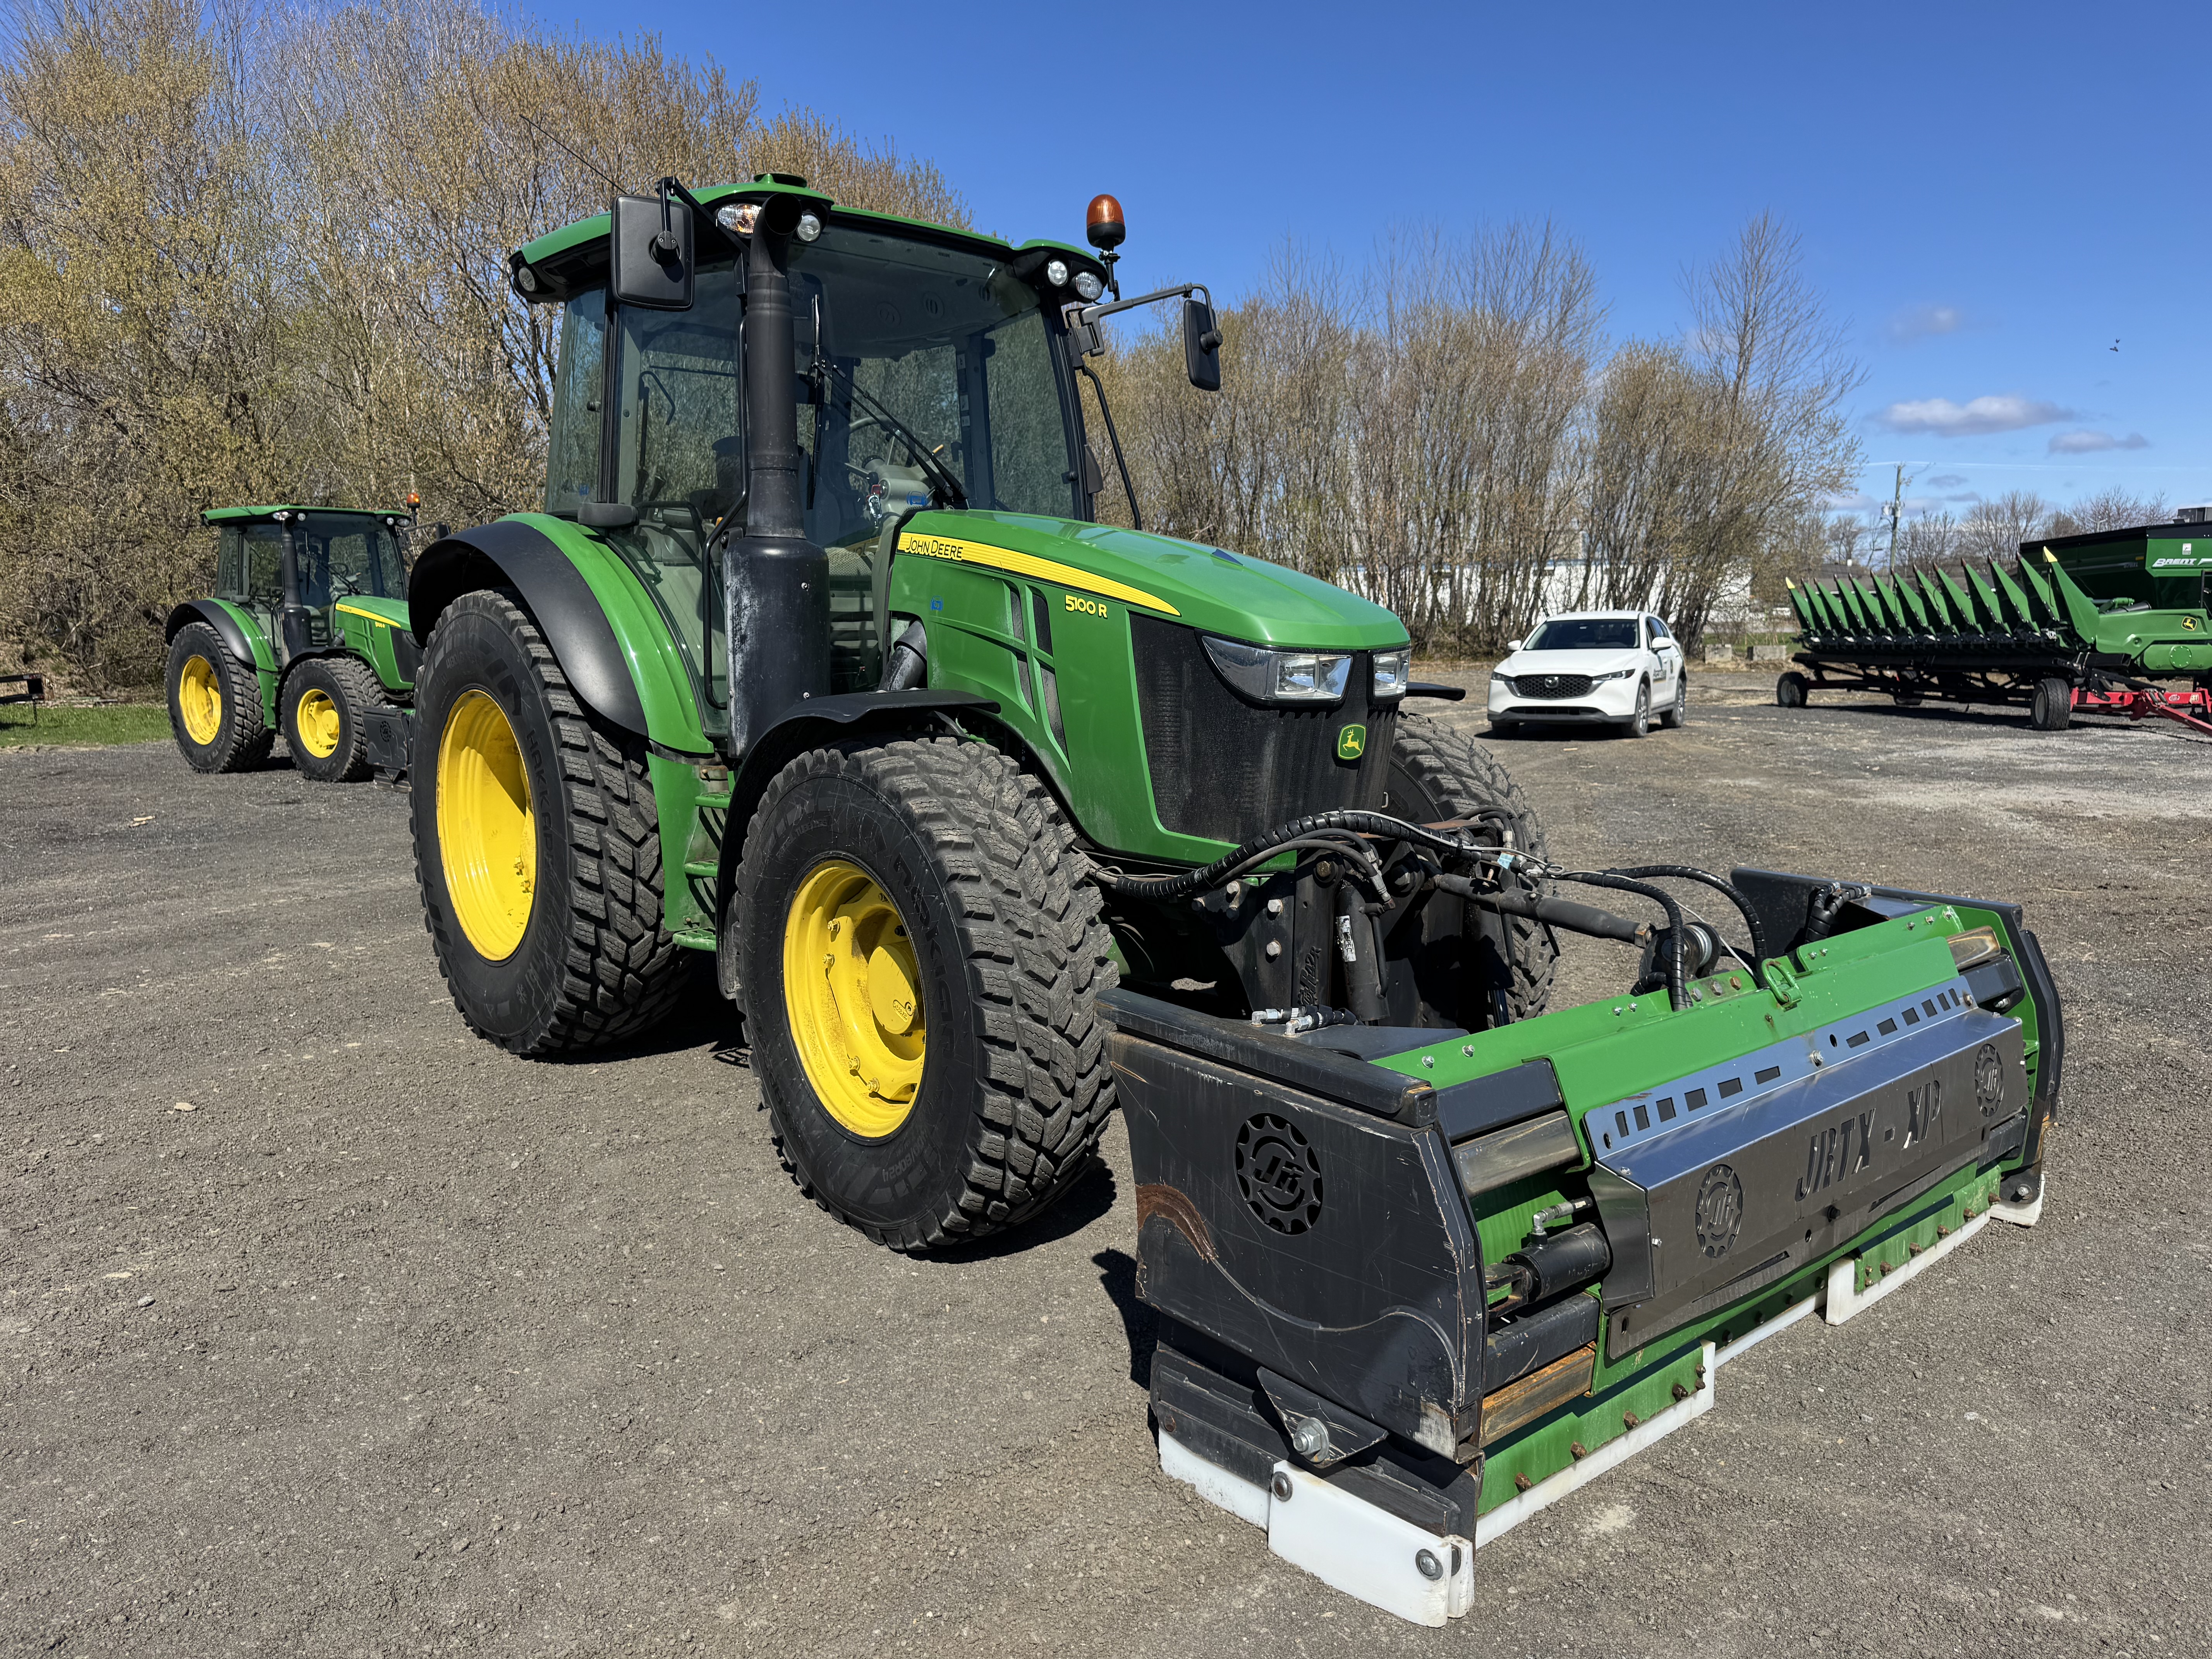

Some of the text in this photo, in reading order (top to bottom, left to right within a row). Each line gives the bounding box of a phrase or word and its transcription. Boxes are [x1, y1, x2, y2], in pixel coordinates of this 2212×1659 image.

[906, 537, 963, 558] JOHN DEERE
[2152, 558, 2197, 567] BRENT
[1065, 594, 1108, 618] 5100 R
